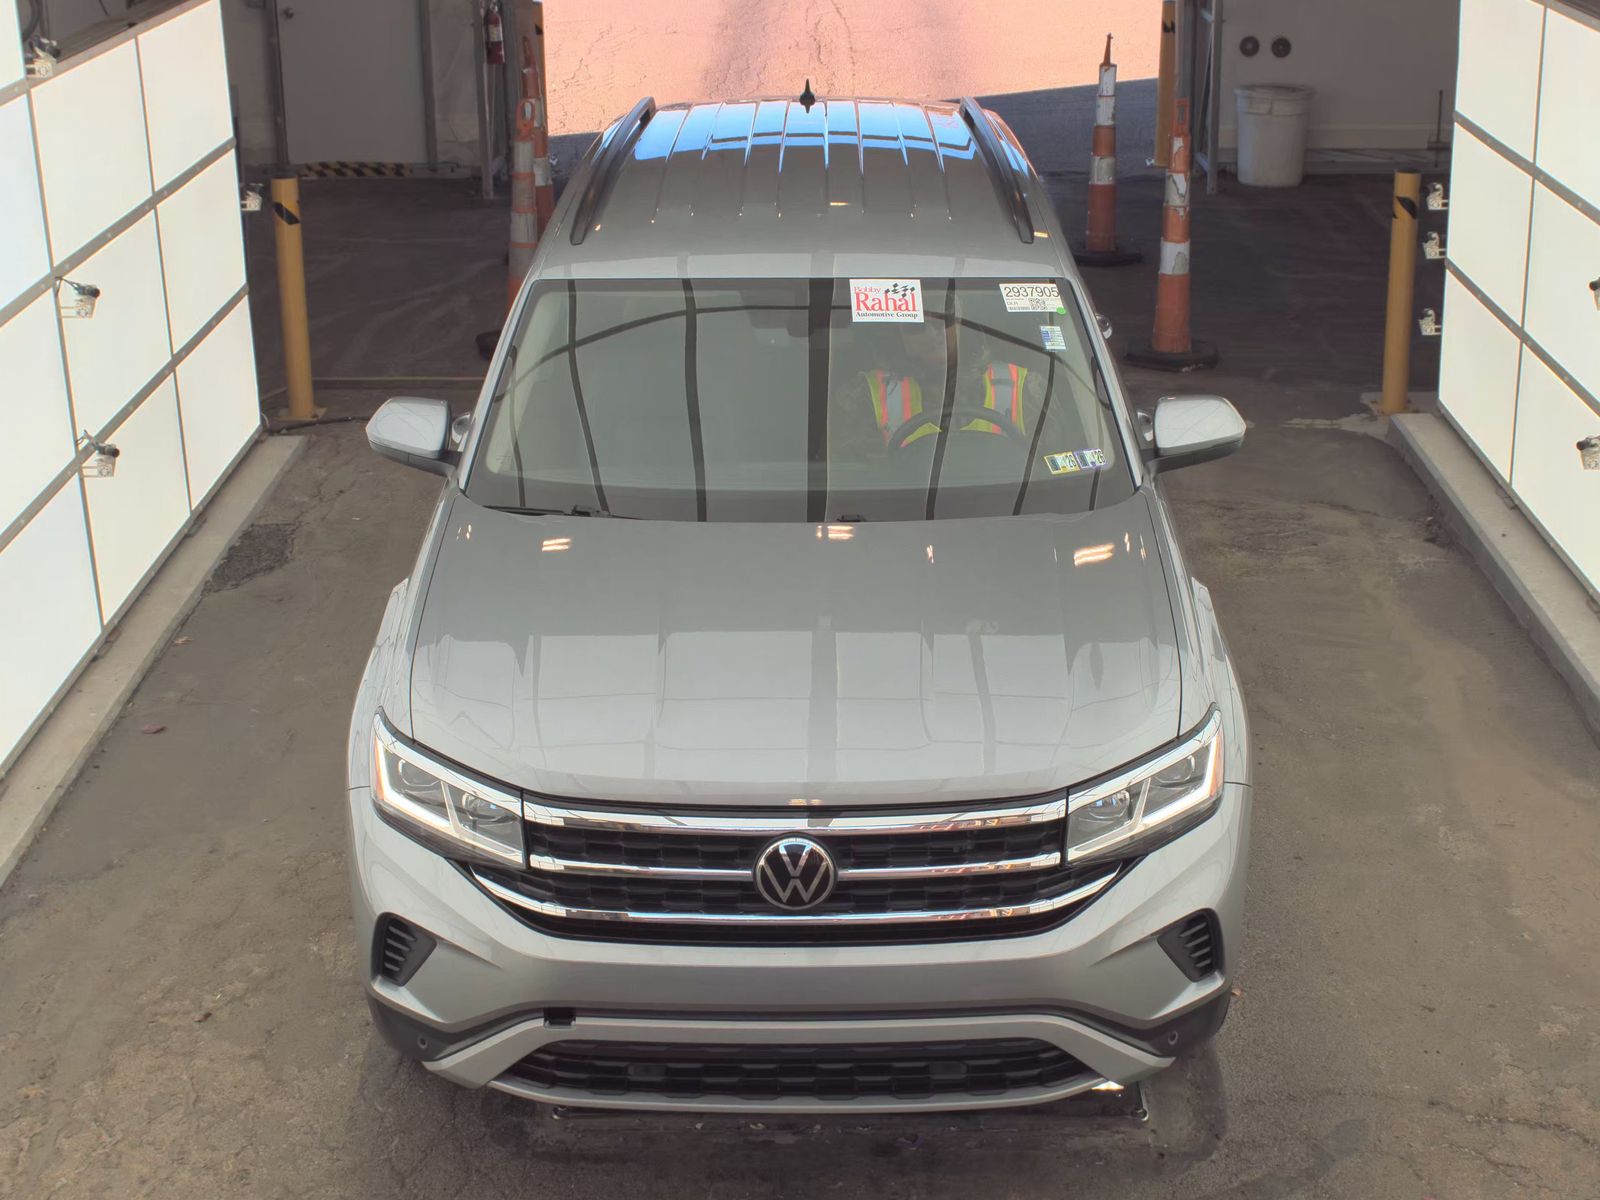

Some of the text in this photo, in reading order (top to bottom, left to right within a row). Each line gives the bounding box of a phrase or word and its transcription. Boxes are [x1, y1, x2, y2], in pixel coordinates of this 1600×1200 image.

[1004, 286, 1060, 298] 2937905
[855, 290, 919, 312] Rahal
[896, 311, 918, 320] Group
